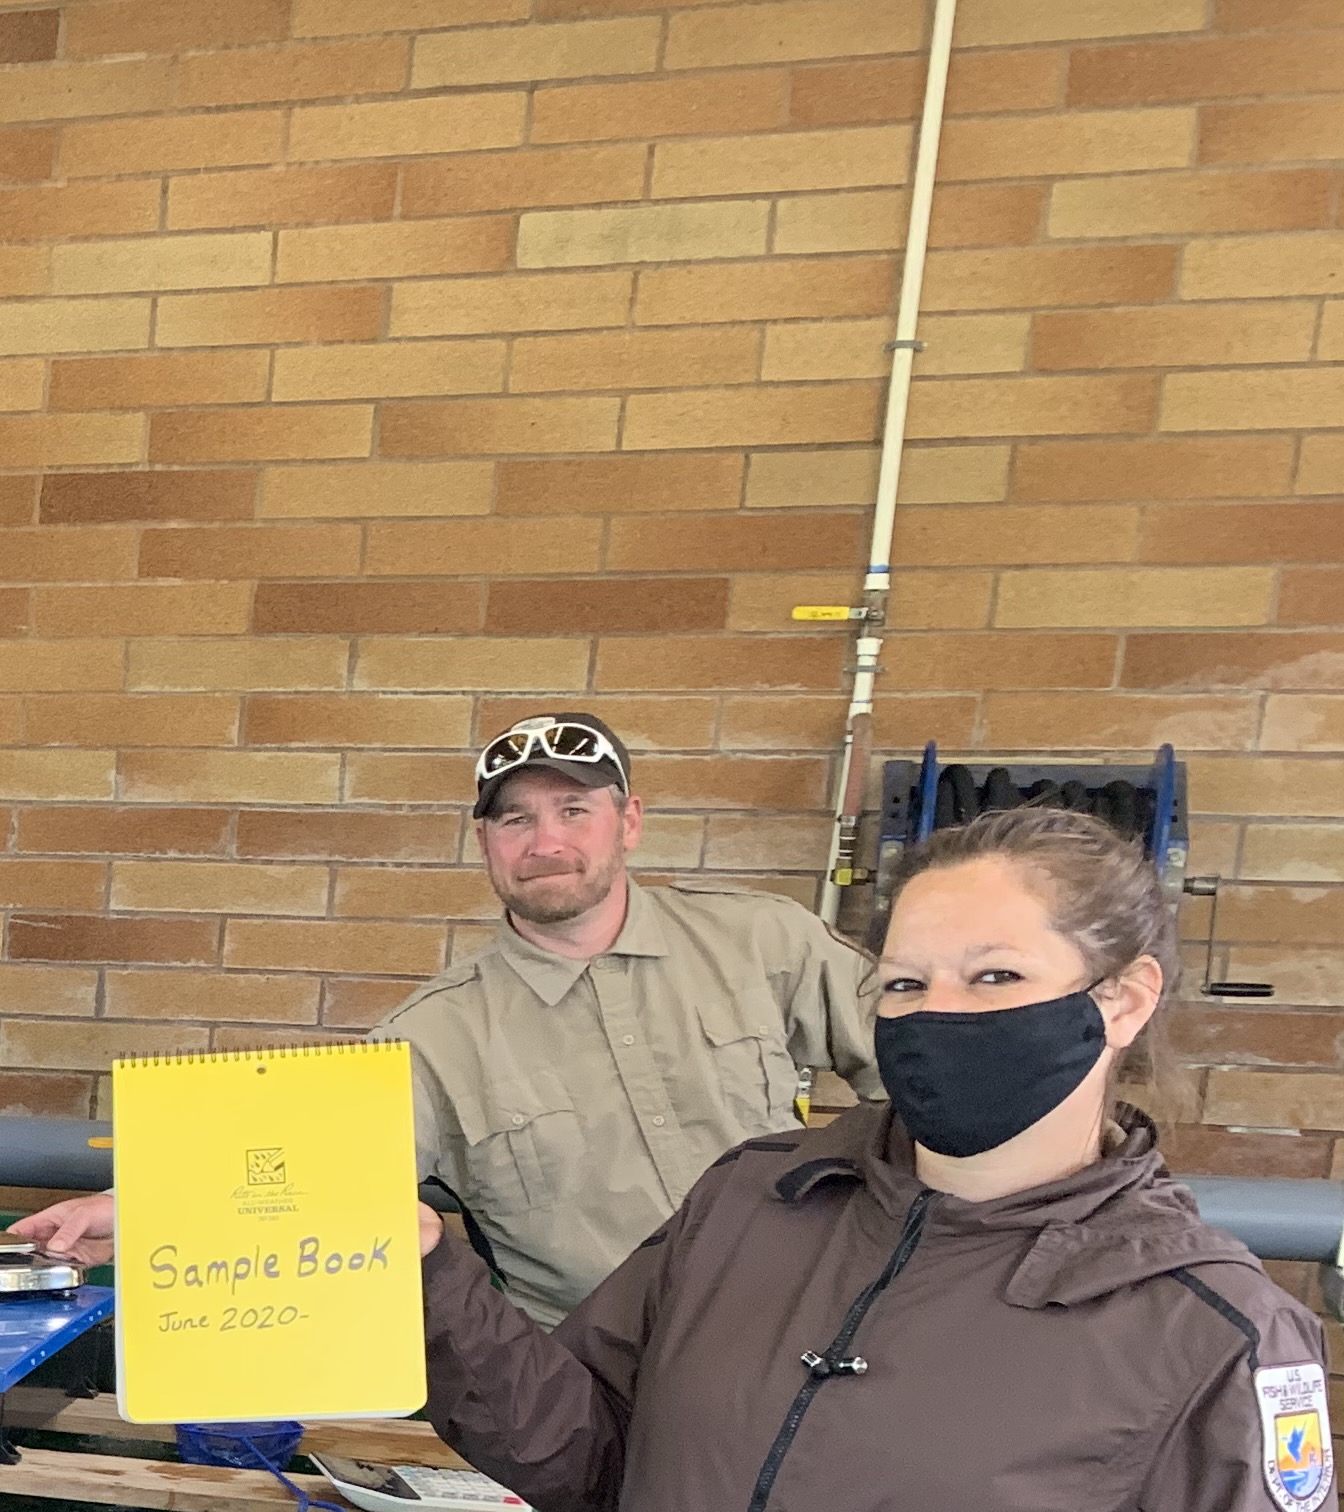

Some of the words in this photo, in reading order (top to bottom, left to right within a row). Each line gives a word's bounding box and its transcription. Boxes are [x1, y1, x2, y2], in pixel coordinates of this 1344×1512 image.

[237, 1205, 299, 1215] UNIVERSAL
[149, 1244, 281, 1296] Sample
[158, 1311, 210, 1333] June
[1288, 1379, 1323, 1397] WILDLIFE
[1279, 1395, 1313, 1411] SERVICE
